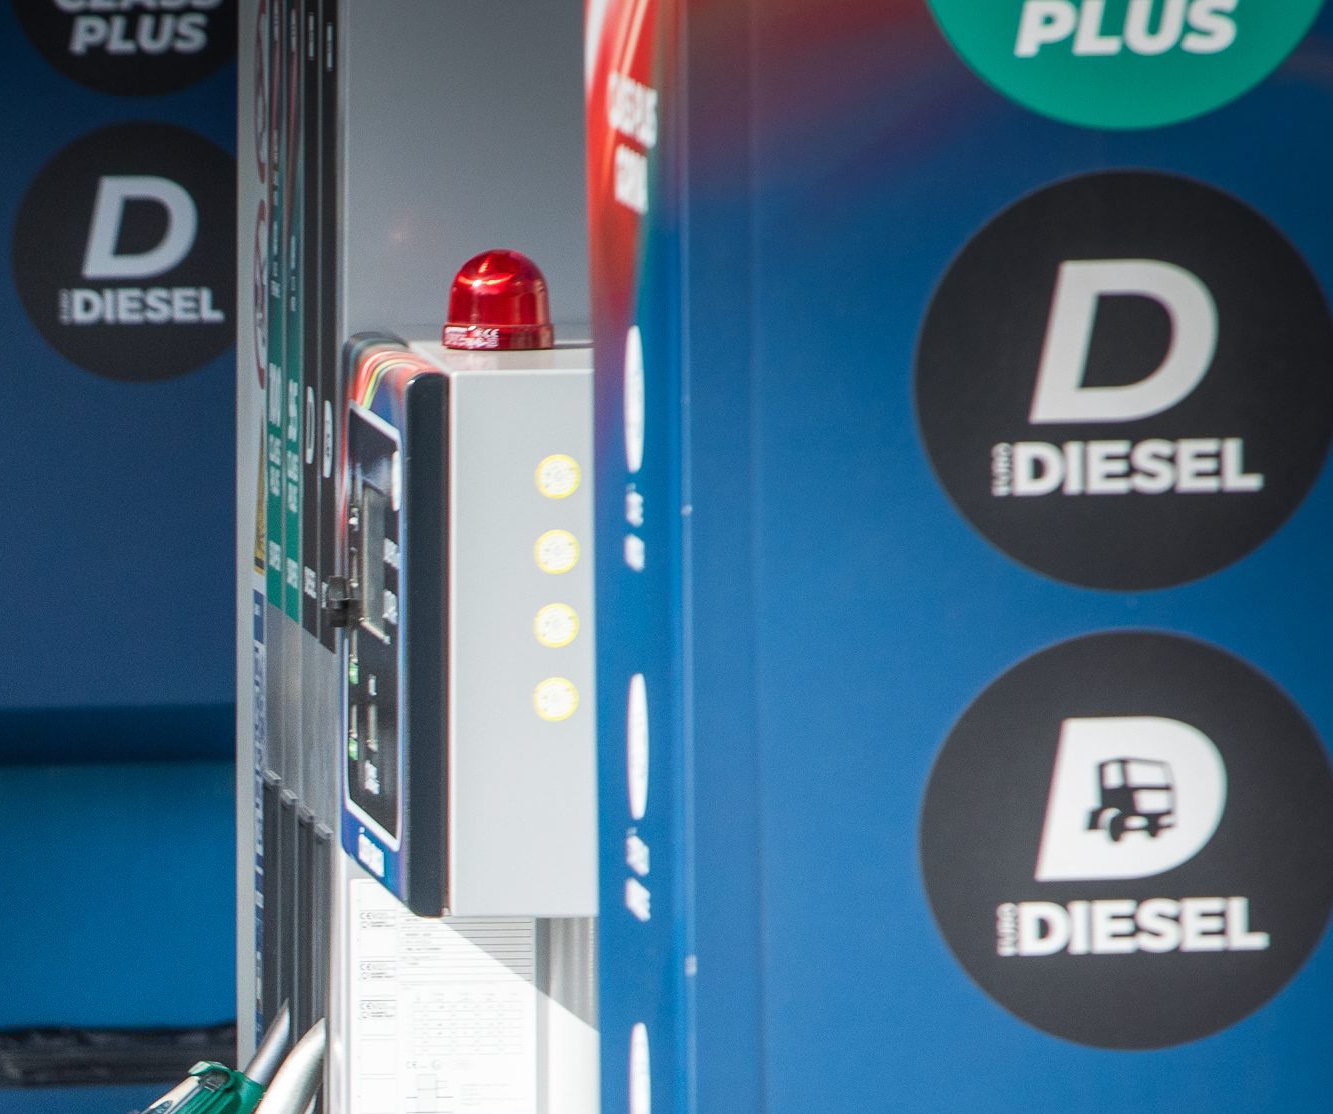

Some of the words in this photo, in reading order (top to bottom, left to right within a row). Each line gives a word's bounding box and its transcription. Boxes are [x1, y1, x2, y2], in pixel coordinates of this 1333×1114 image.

[69, 12, 209, 56] PLUS
[1014, 0, 1237, 57] PLUS
[81, 174, 199, 280] D
[73, 286, 226, 325] DIESEL
[1030, 258, 1219, 425] D
[1012, 437, 1265, 497] DIESEL
[1034, 715, 1228, 882] D
[1018, 896, 1271, 957] DIESEL
